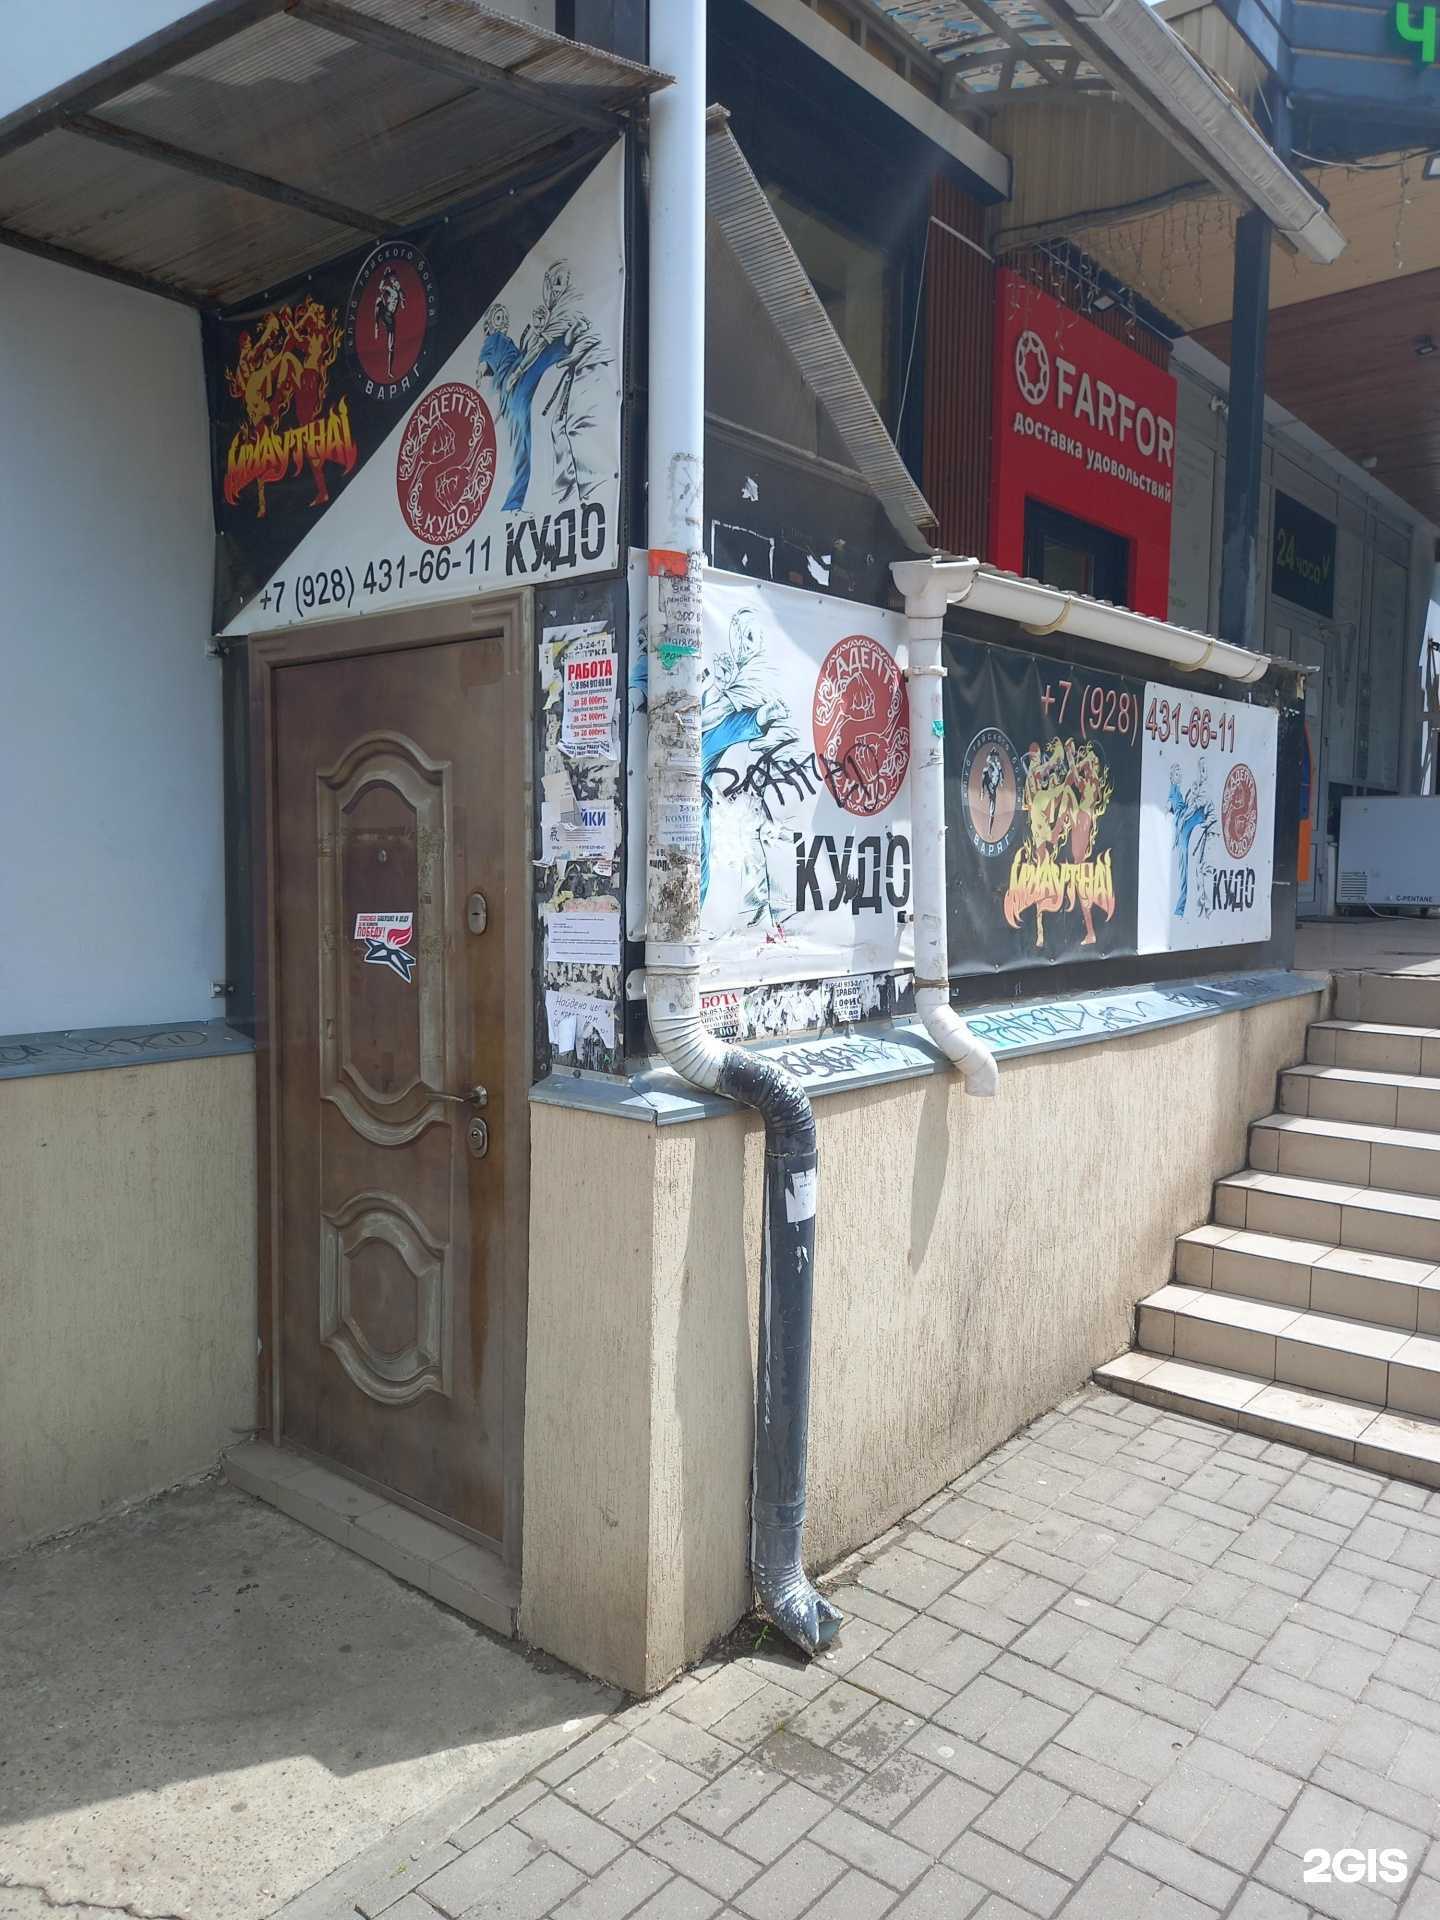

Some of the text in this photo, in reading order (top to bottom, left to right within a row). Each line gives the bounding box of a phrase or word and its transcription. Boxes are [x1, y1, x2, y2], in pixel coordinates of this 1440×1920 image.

[365, 363, 420, 400] ВАРЯГ
[417, 393, 477, 435] АДЕПТ
[1055, 356, 1174, 468] FARFOR
[1013, 412, 1172, 503] доставка удовольствий
[424, 505, 469, 538] КУДО
[505, 502, 606, 577] КУДО
[259, 536, 491, 617] +7 (928) 431-66-11
[568, 659, 613, 680] РАБОТА
[836, 647, 894, 686] АДЕПТ
[1041, 680, 1236, 753] +7 (928) 431-66-11
[842, 777, 887, 808] КУДО
[581, 809, 606, 826] ЙКИ
[973, 834, 1010, 855] ВАРЯГ
[794, 832, 911, 916] КУДО
[1212, 867, 1256, 912] КУДО
[702, 992, 739, 1009] БОТА
